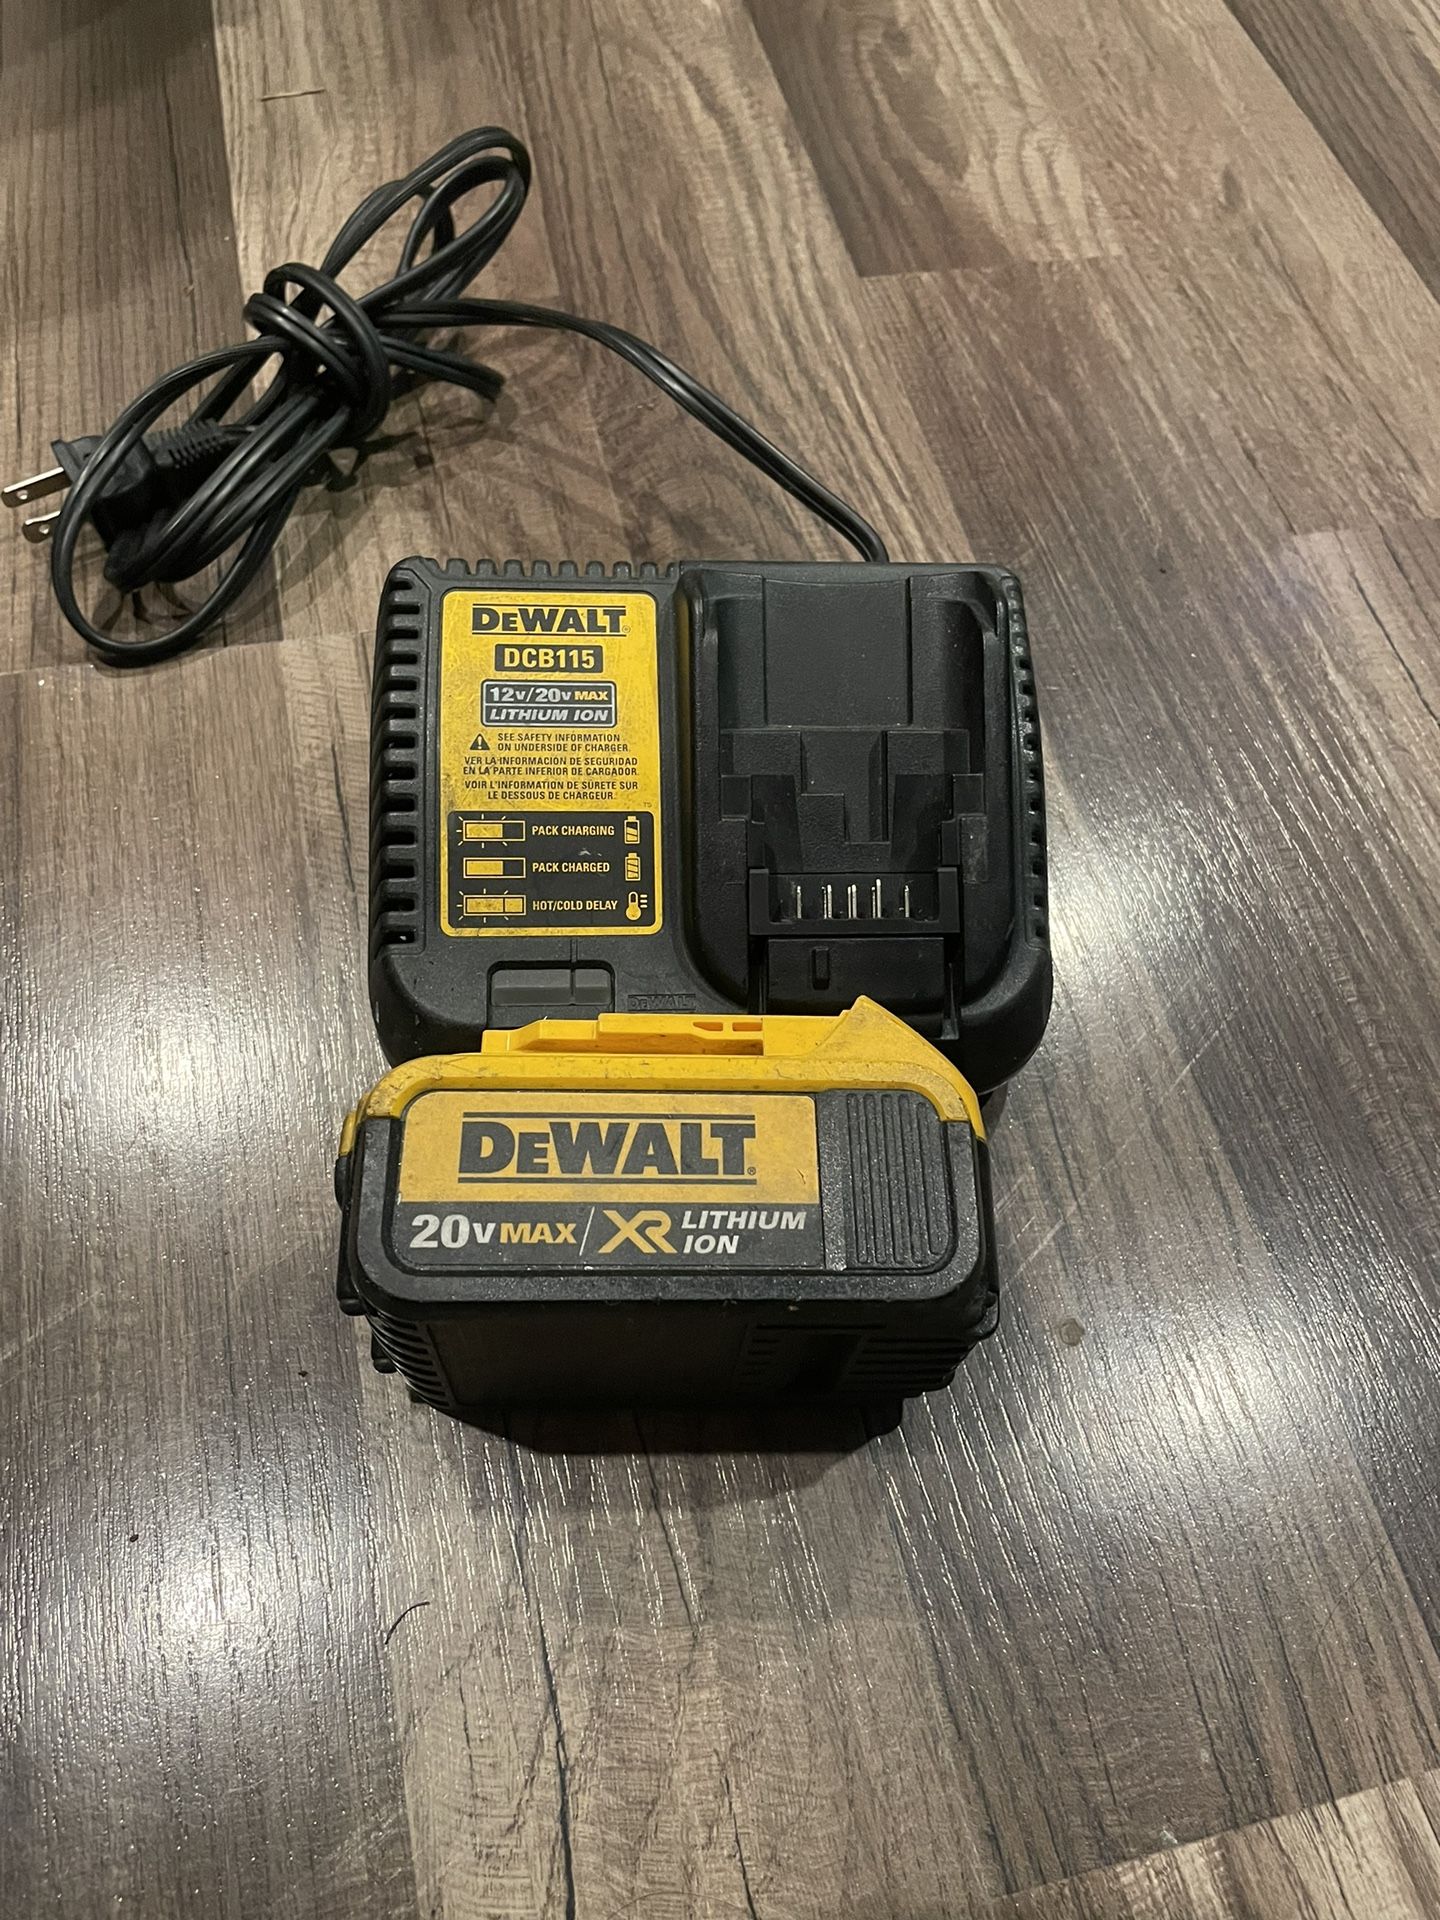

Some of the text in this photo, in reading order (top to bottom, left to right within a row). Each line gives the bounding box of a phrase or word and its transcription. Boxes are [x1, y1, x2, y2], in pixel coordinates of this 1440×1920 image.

[503, 647, 595, 669] DCB115
[574, 690, 609, 701] MAX
[489, 708, 609, 721] LITHIUM ION
[497, 733, 620, 742] SEE SAFETY INFORMATION
[497, 743, 512, 751] ON
[514, 743, 568, 752] UNDERSIDE
[571, 743, 582, 752] OF
[464, 757, 482, 765] VER
[485, 757, 497, 765] LA
[569, 757, 581, 765] DE
[584, 757, 638, 766] SEGURIDAD
[463, 766, 475, 775] EN
[479, 766, 490, 775] LA
[493, 767, 523, 775] PARTE
[526, 767, 568, 775] INFERIOR
[571, 767, 583, 776] DE
[464, 781, 487, 789] VOIR
[490, 781, 564, 789] L'INFORMATION
[567, 781, 579, 790] DE
[619, 781, 638, 790] SUR
[488, 791, 499, 799] LE
[501, 791, 546, 800] DESSOUS
[548, 791, 560, 800] DE
[531, 825, 616, 836] PACK CHARGING
[532, 862, 610, 873] PACK CHARGED
[532, 900, 618, 911] HOT/COLD DELAY
[499, 1222, 577, 1245] MAX
[597, 1209, 682, 1255] XR
[681, 1210, 807, 1231] LITHIUM
[683, 1235, 739, 1254] ION
